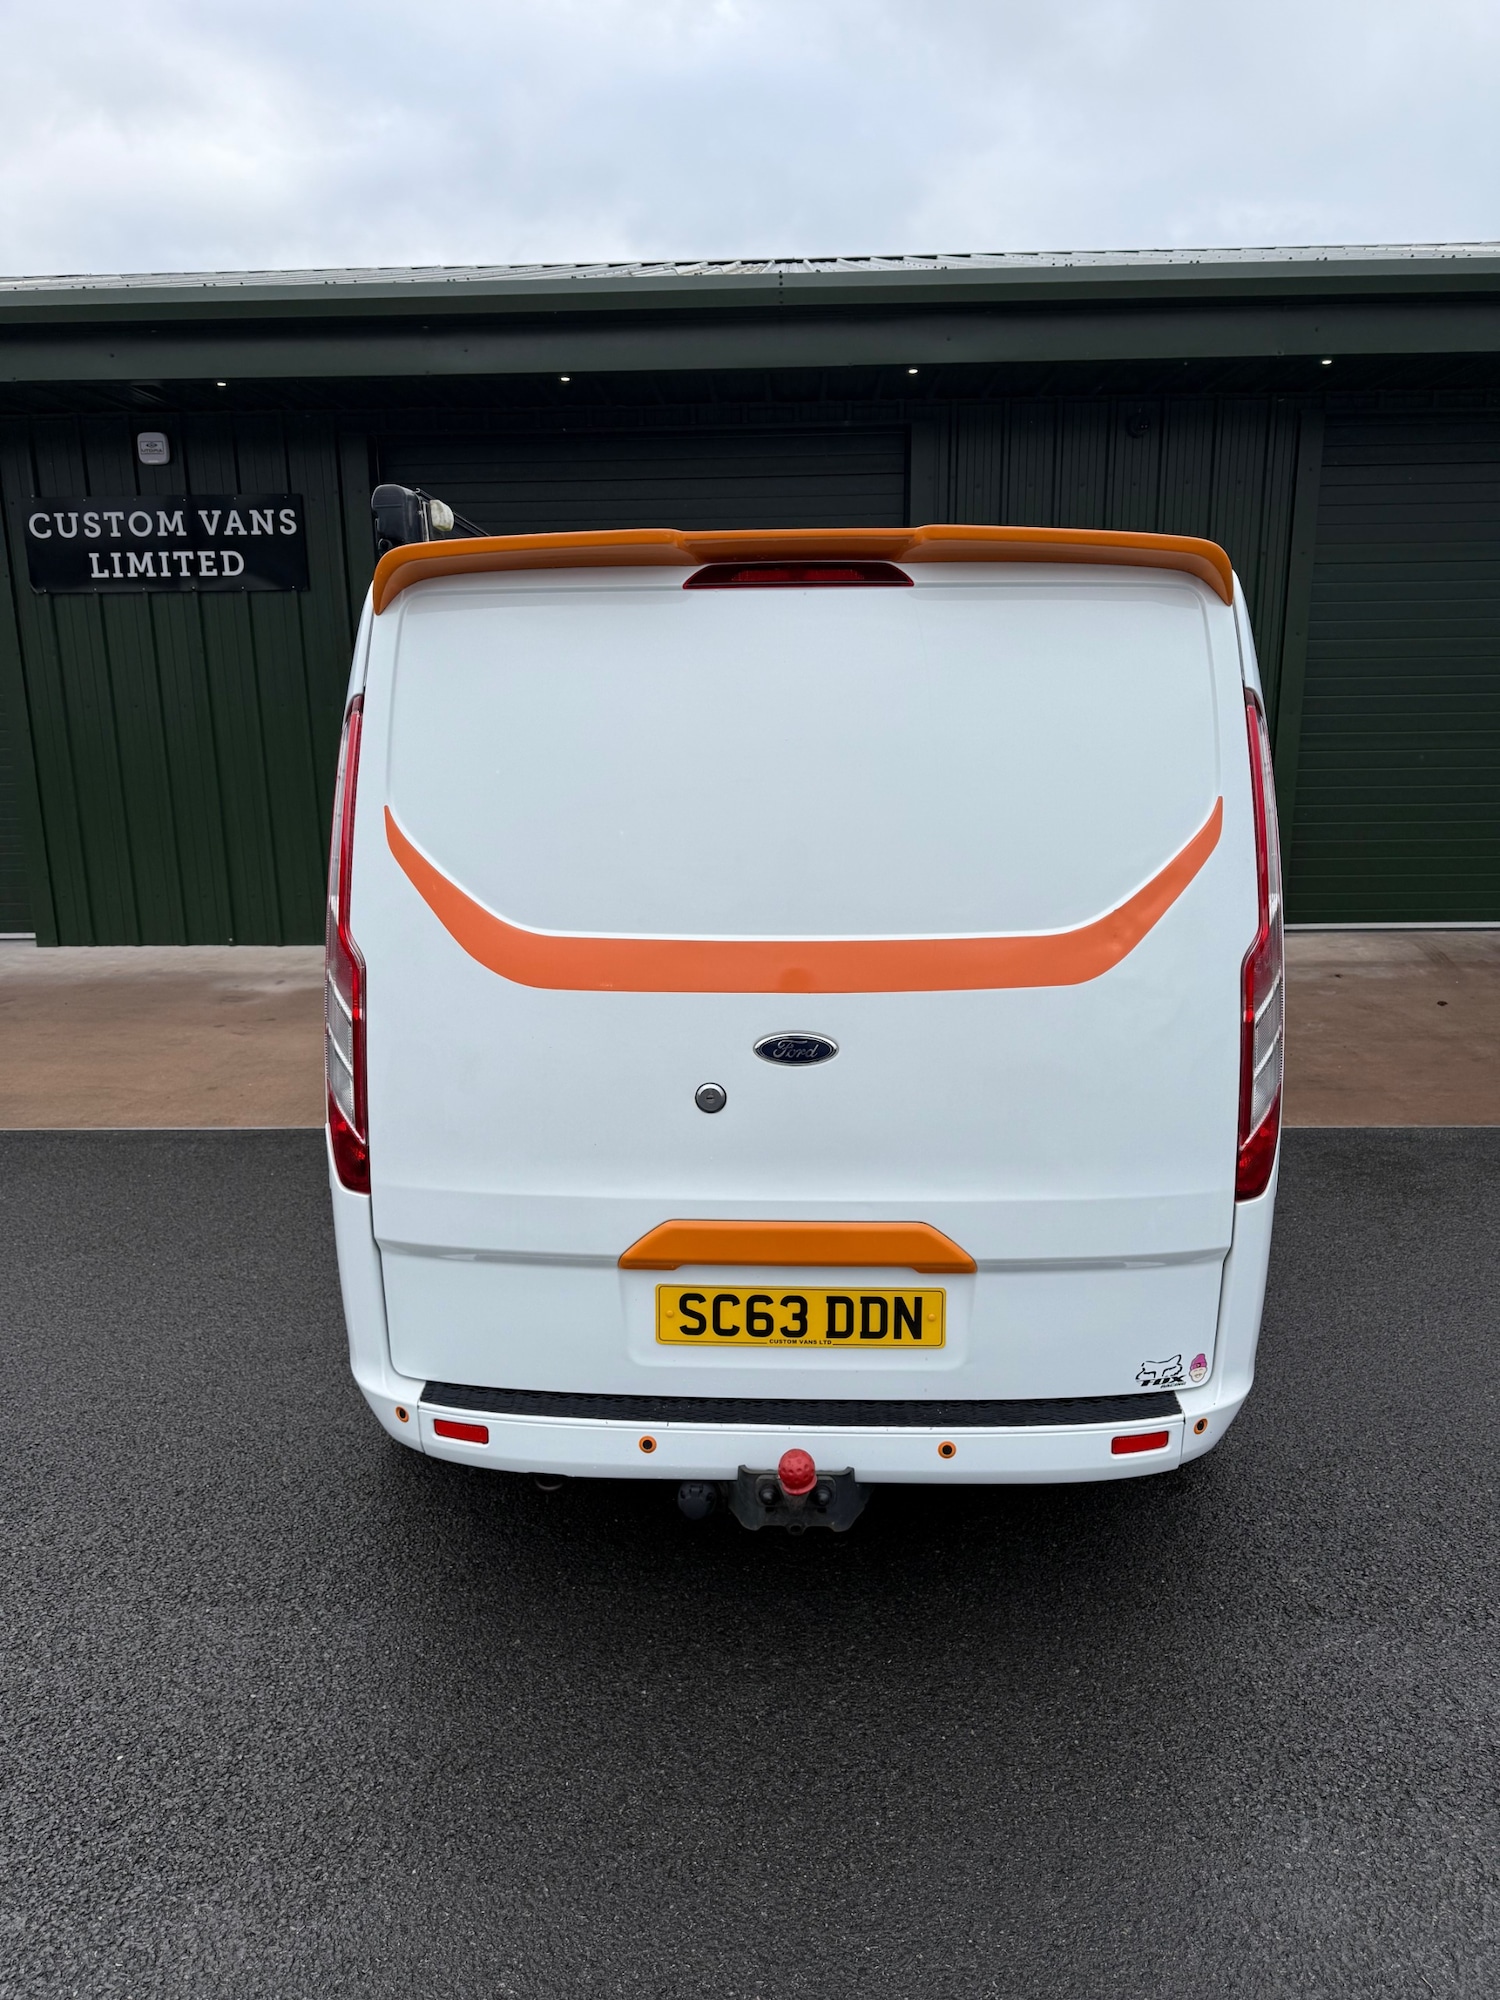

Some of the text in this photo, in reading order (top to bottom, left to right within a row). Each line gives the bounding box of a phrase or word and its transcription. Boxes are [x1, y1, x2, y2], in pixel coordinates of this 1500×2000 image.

[28, 508, 298, 539] CUSTOM VANS
[88, 550, 245, 579] LIMITED
[773, 1039, 818, 1059] Ford
[678, 1292, 923, 1340] SC63 DDN
